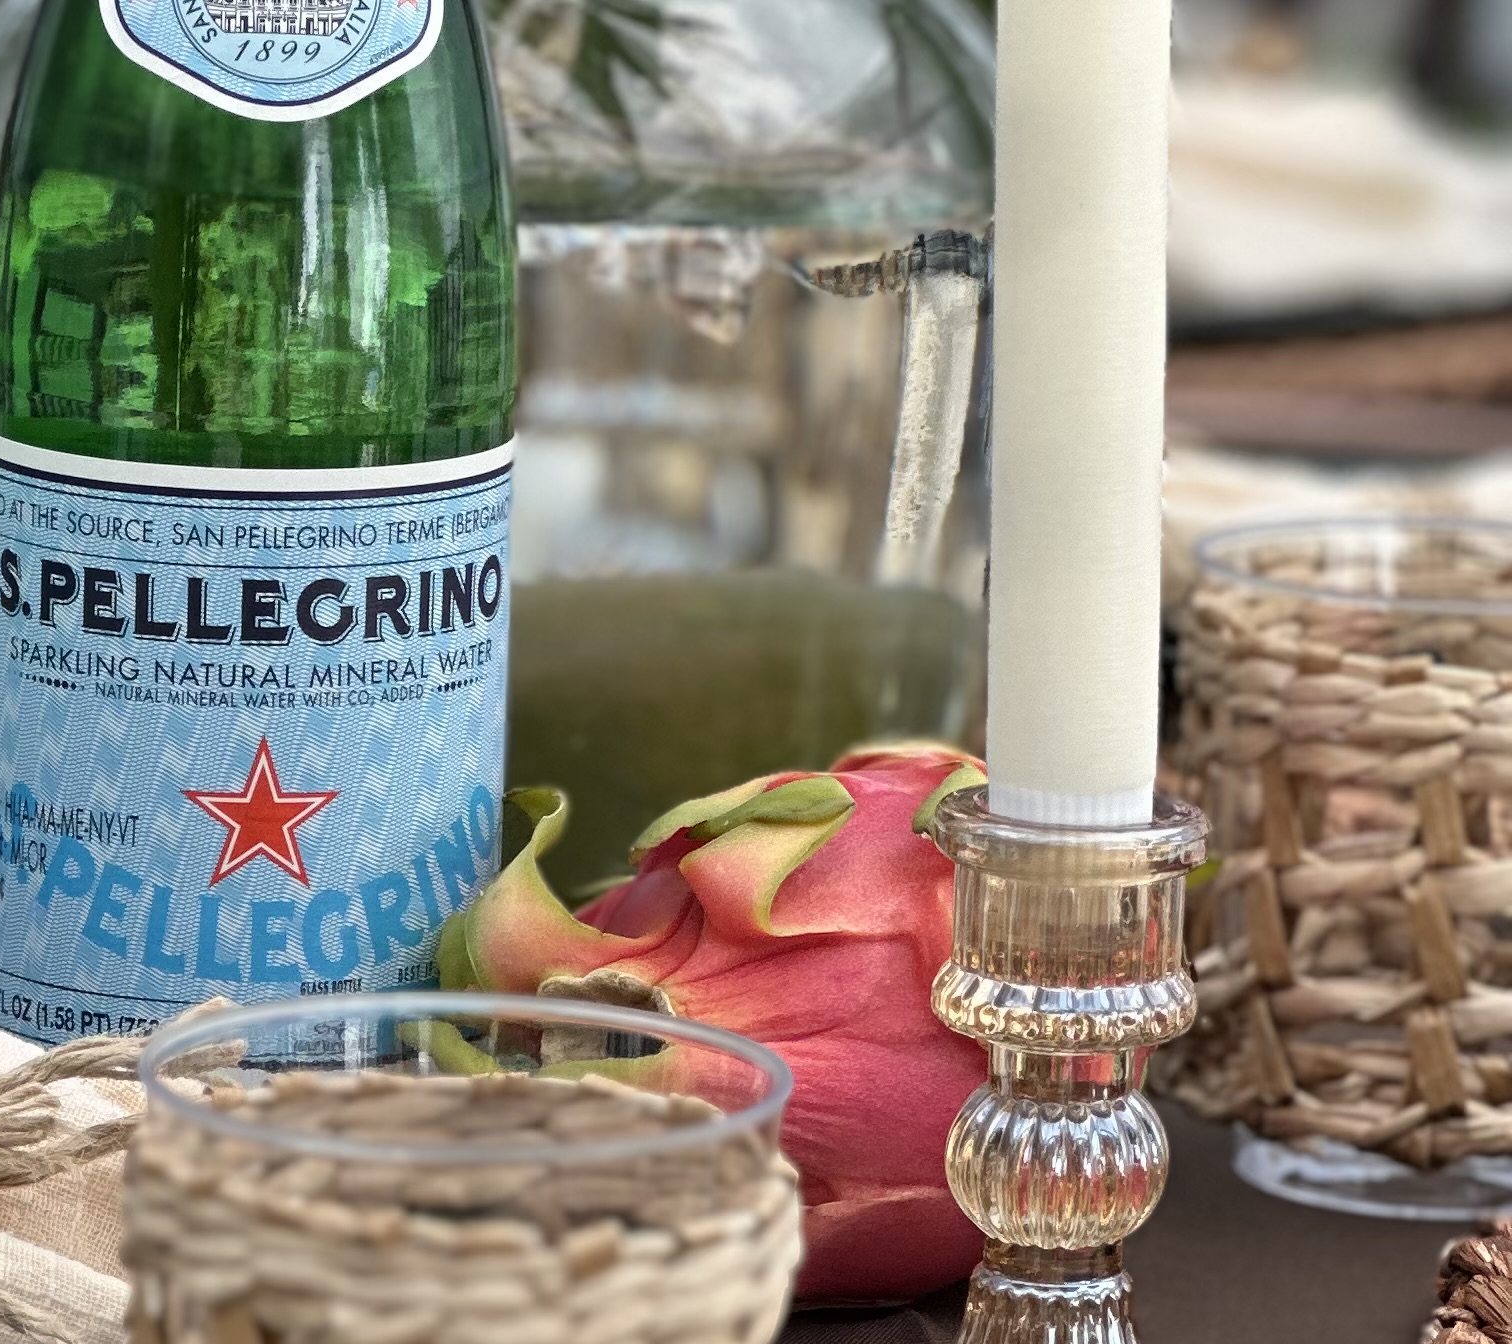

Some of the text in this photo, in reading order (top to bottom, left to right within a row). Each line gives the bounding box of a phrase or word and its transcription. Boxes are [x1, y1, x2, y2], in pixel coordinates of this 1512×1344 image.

[234, 38, 321, 64] 1899
[30, 503, 58, 531] THE
[65, 510, 161, 548] SOURCE,
[172, 522, 224, 547] SAN
[235, 523, 377, 550] PELLEGRINO
[387, 515, 444, 546] TERME
[0, 549, 502, 646] S.PELLEGRINO
[10, 636, 493, 688] SPARKLING NATURAL MINERAL WATER
[95, 681, 162, 705] NATURAL
[167, 690, 236, 707] MINERAL
[243, 691, 295, 708] WATER
[303, 690, 341, 707] WITH
[381, 683, 423, 703] ADDED
[11, 994, 33, 1022] OZ
[37, 1000, 75, 1032] (1.58
